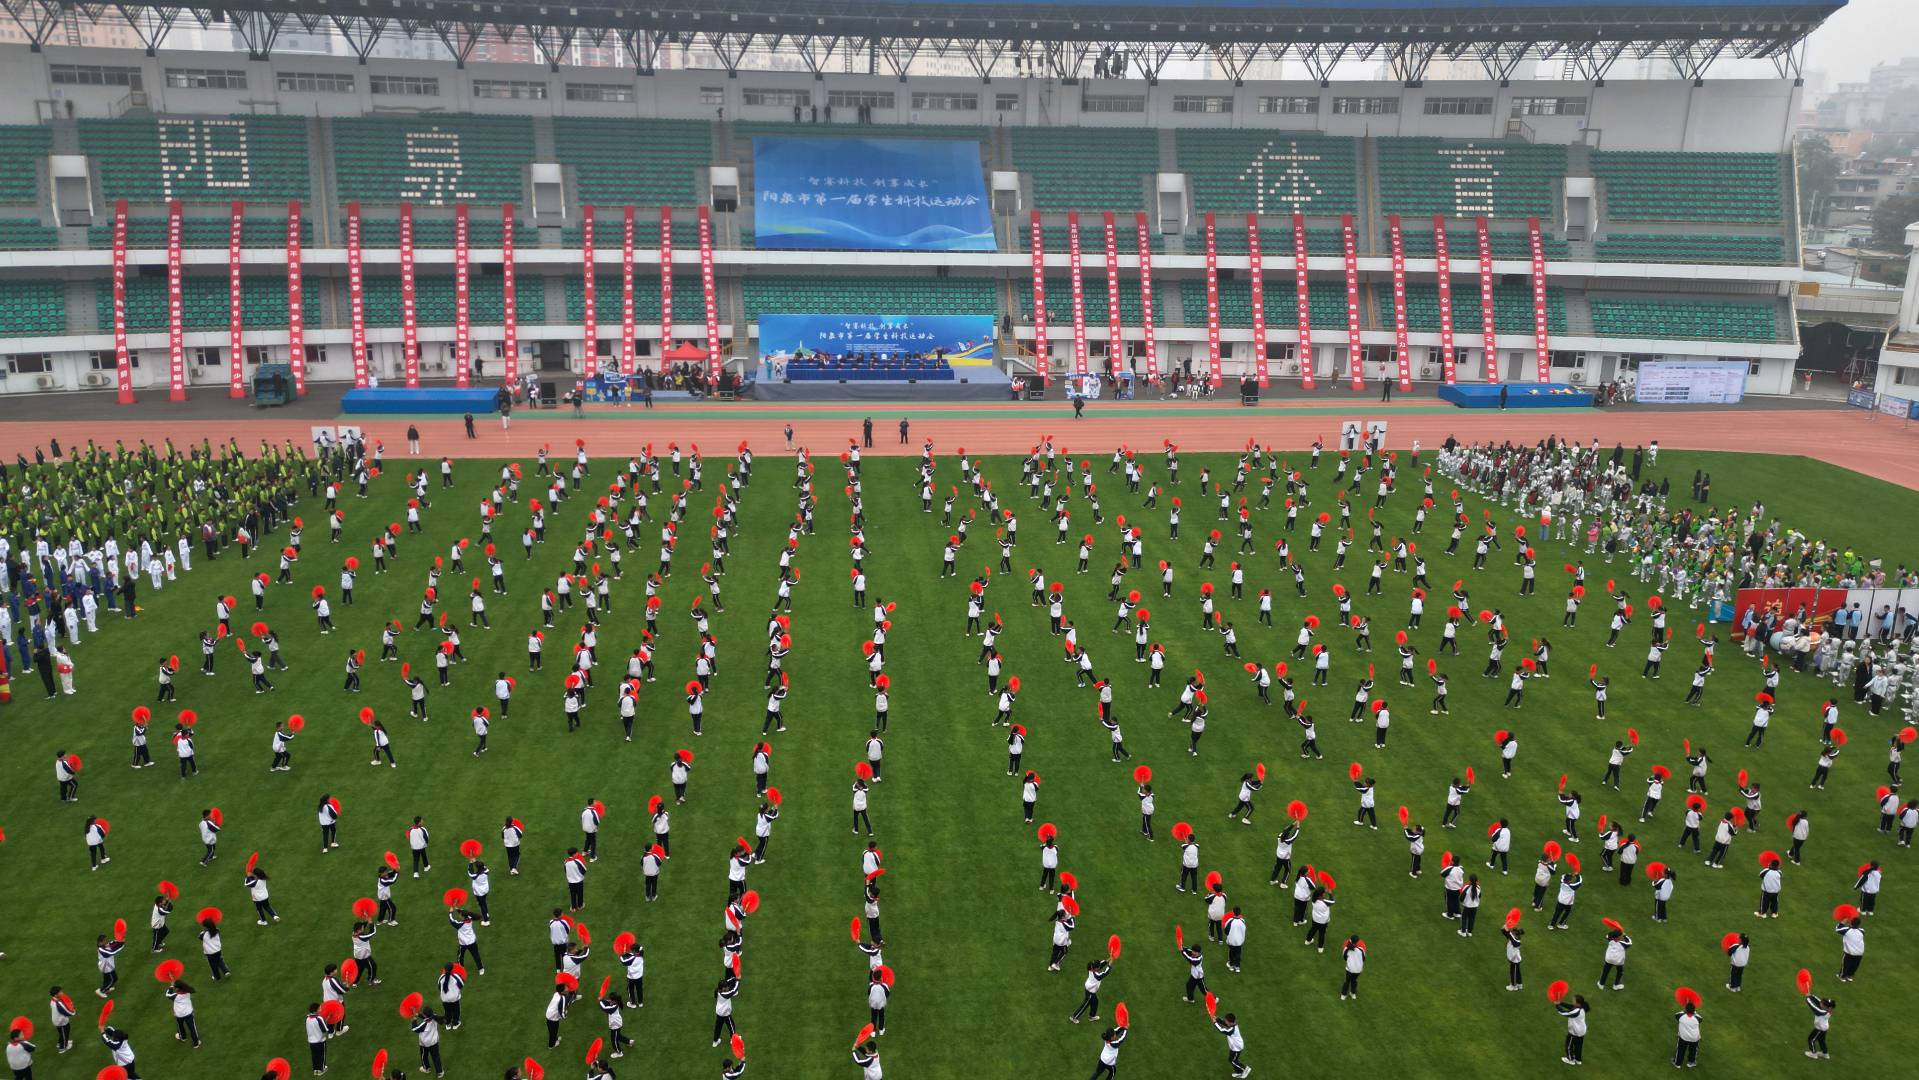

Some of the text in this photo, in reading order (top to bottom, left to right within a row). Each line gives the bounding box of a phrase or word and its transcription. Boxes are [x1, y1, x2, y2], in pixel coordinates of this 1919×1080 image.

[159, 119, 476, 205] 阳 泉
[1239, 142, 1504, 217] 体 育
[762, 190, 979, 207] 阳泉市第一届学生科技运动会
[820, 331, 935, 340] 阳泉市第一届学生科技运动会
